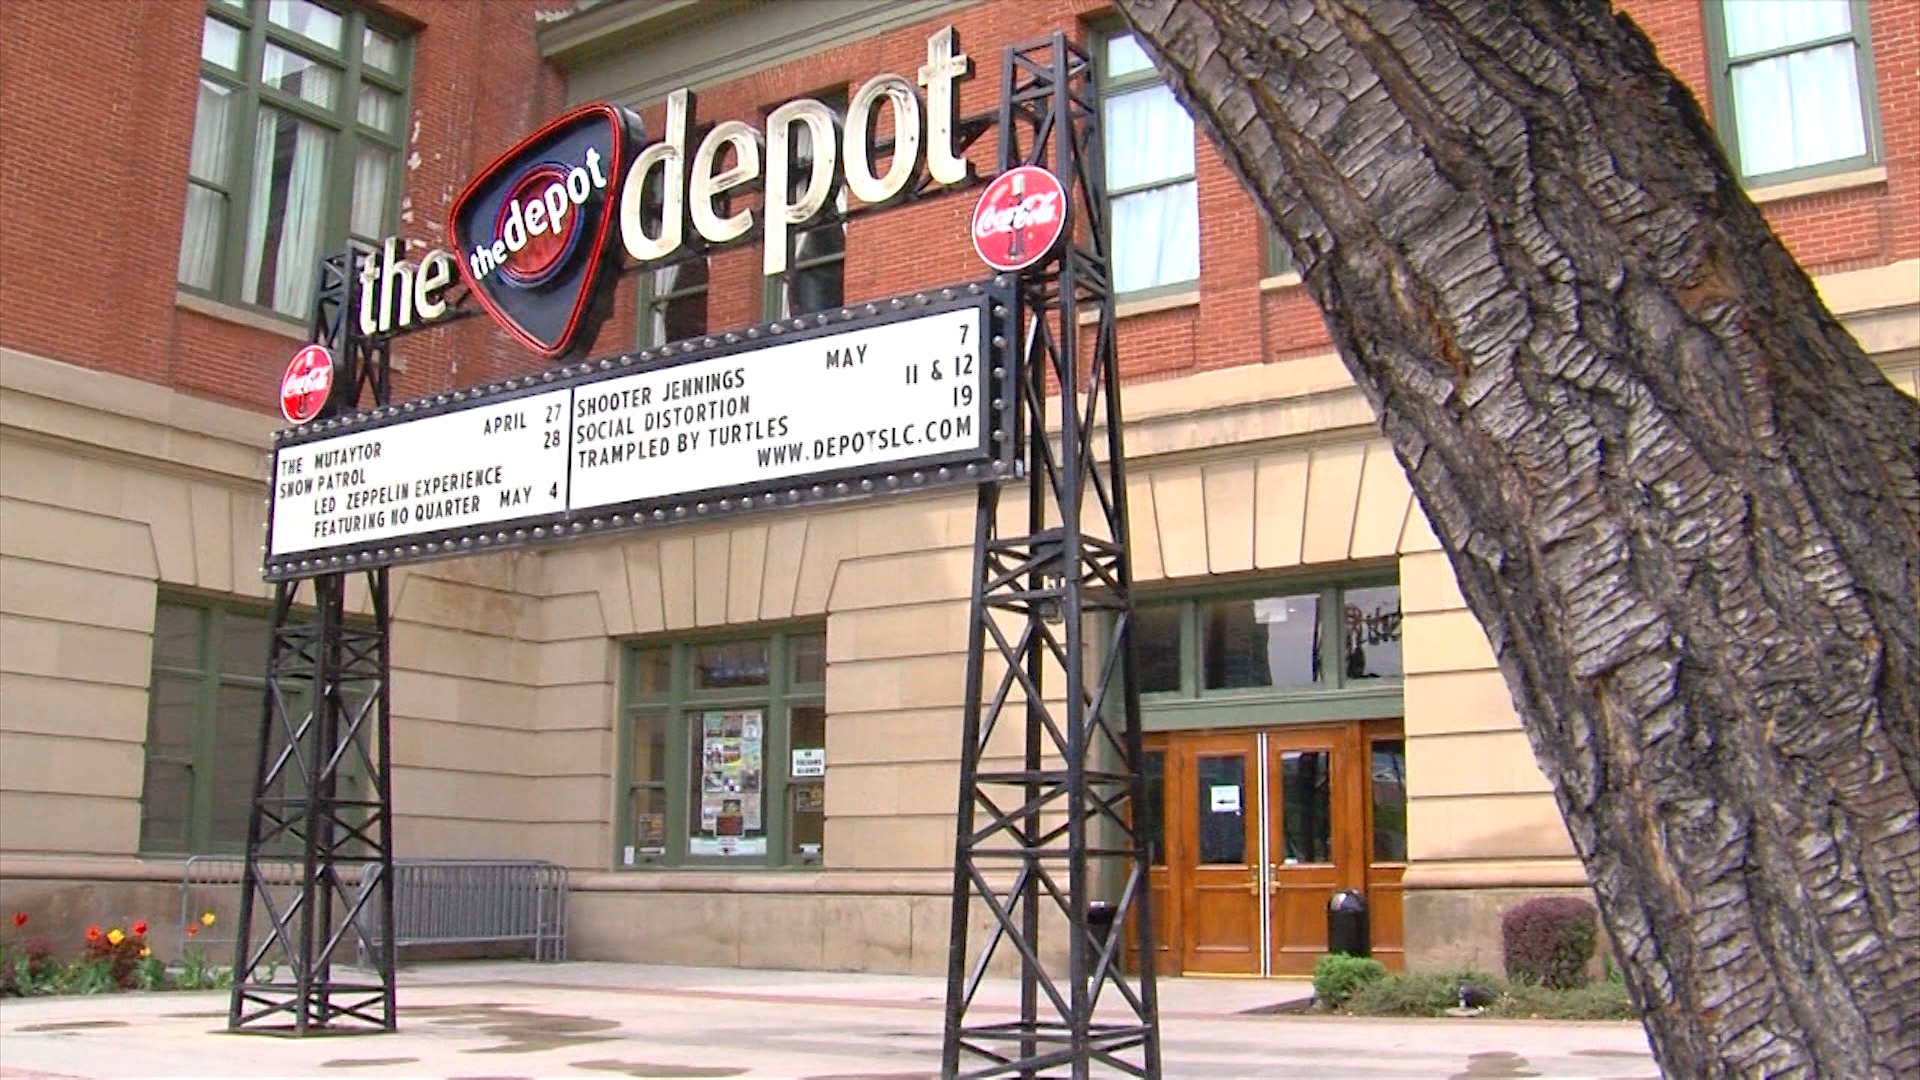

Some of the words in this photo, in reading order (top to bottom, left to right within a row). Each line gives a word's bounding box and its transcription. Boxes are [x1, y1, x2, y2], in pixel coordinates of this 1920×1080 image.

[358, 237, 454, 336] the
[620, 24, 968, 277] depot
[470, 242, 508, 281] the
[502, 147, 607, 254] depot
[577, 417, 634, 444] SOCIAL
[645, 395, 749, 431] DISTORTION
[906, 365, 917, 384] 11
[931, 359, 943, 381] &
[955, 353, 972, 376] 12
[578, 387, 651, 418] SHOOTER
[662, 368, 744, 402] JENNINGS
[827, 344, 867, 369] MAY
[960, 324, 969, 344] 7
[280, 480, 313, 498] SNOW
[318, 469, 365, 489] PATROL
[544, 430, 560, 449] 28
[282, 457, 303, 473] THE
[315, 442, 381, 468] MUTAYTOR
[484, 413, 527, 435] APRIL
[546, 404, 561, 423] 27
[578, 437, 669, 468] TRAMPLED
[678, 432, 699, 453] BY
[709, 415, 788, 447] TURTLES
[954, 385, 972, 407] 19
[315, 497, 336, 516] LED
[347, 484, 408, 510] ZEPPELIN
[415, 466, 501, 496] EXPERIENCE
[315, 511, 385, 537] FEATURING
[391, 507, 408, 524] NO
[415, 495, 480, 521] QUARTER
[500, 486, 531, 507] MAY
[549, 482, 557, 498] 4
